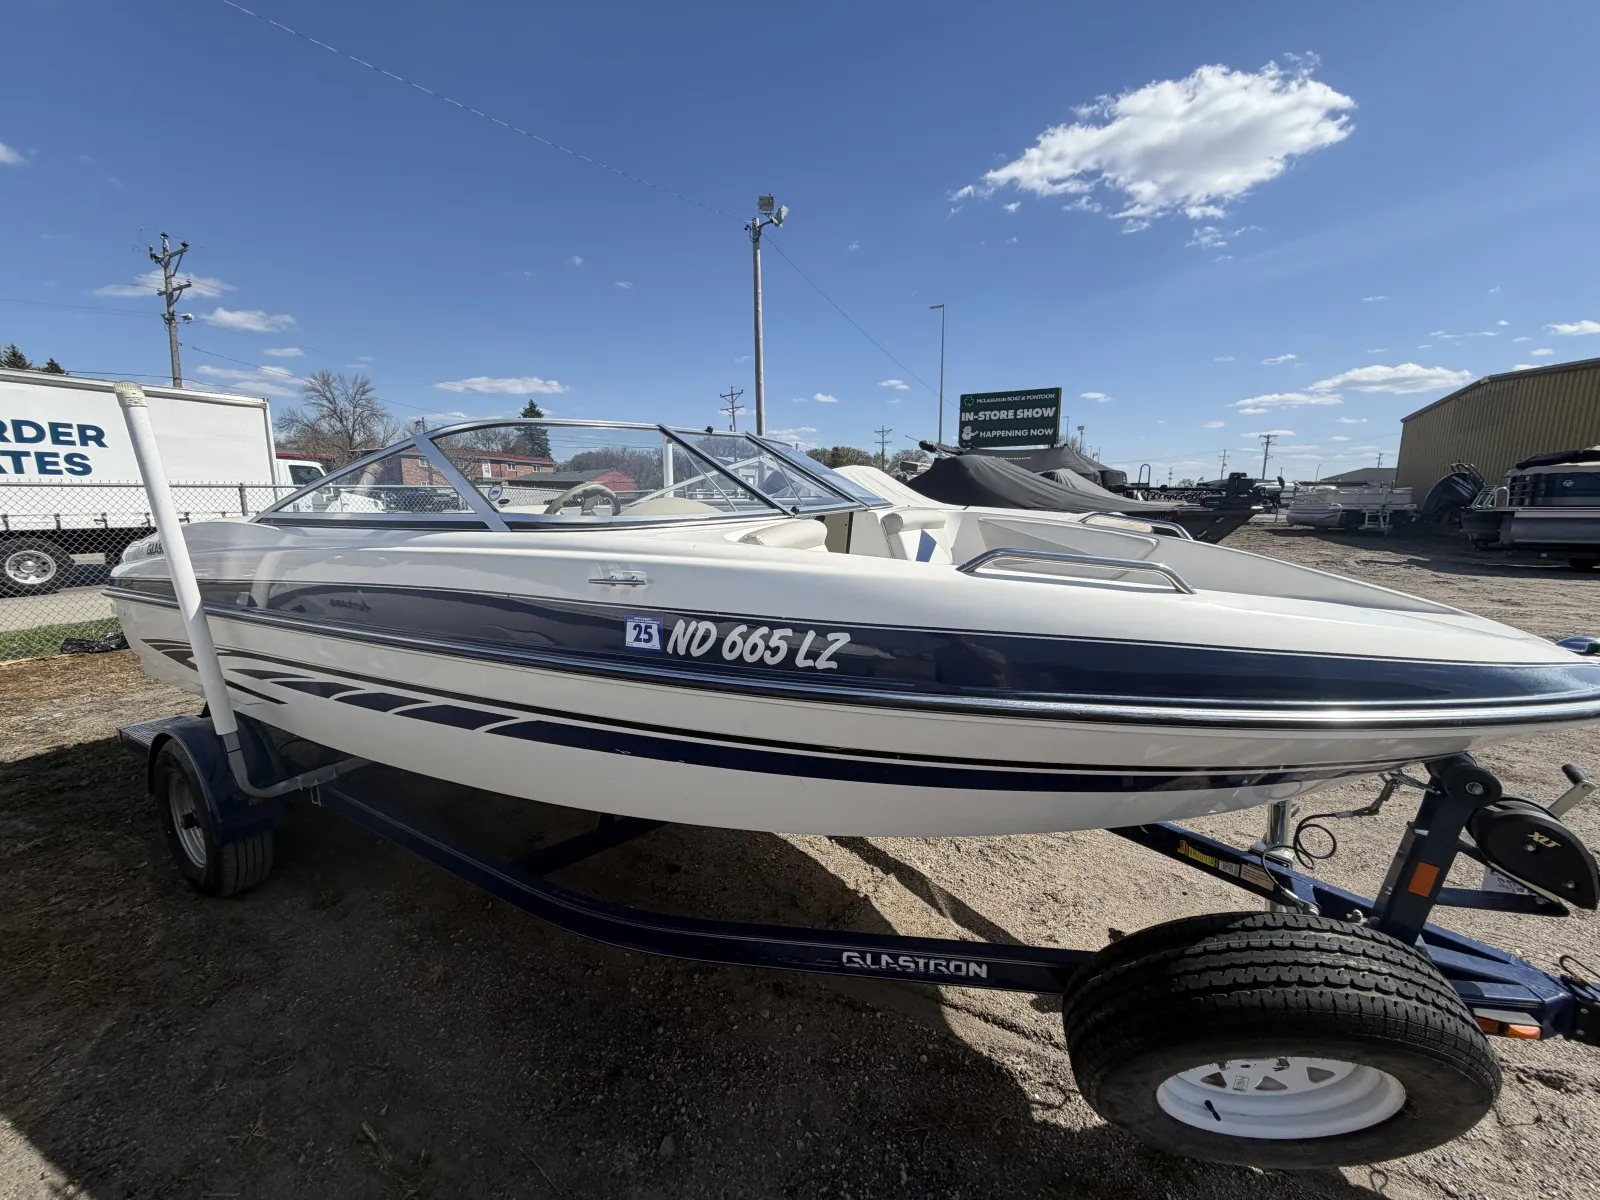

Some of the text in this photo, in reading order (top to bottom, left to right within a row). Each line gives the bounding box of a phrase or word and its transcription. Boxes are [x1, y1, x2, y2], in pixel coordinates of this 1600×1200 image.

[961, 406, 1056, 422] IN-STORE SHOW
[979, 428, 1054, 438] HAPPENING NOW
[0, 450, 93, 477] TES
[633, 623, 653, 643] 25
[666, 619, 851, 670] ND 665 LZ
[1527, 831, 1561, 848] XLT
[842, 951, 988, 979] GLASTRON
